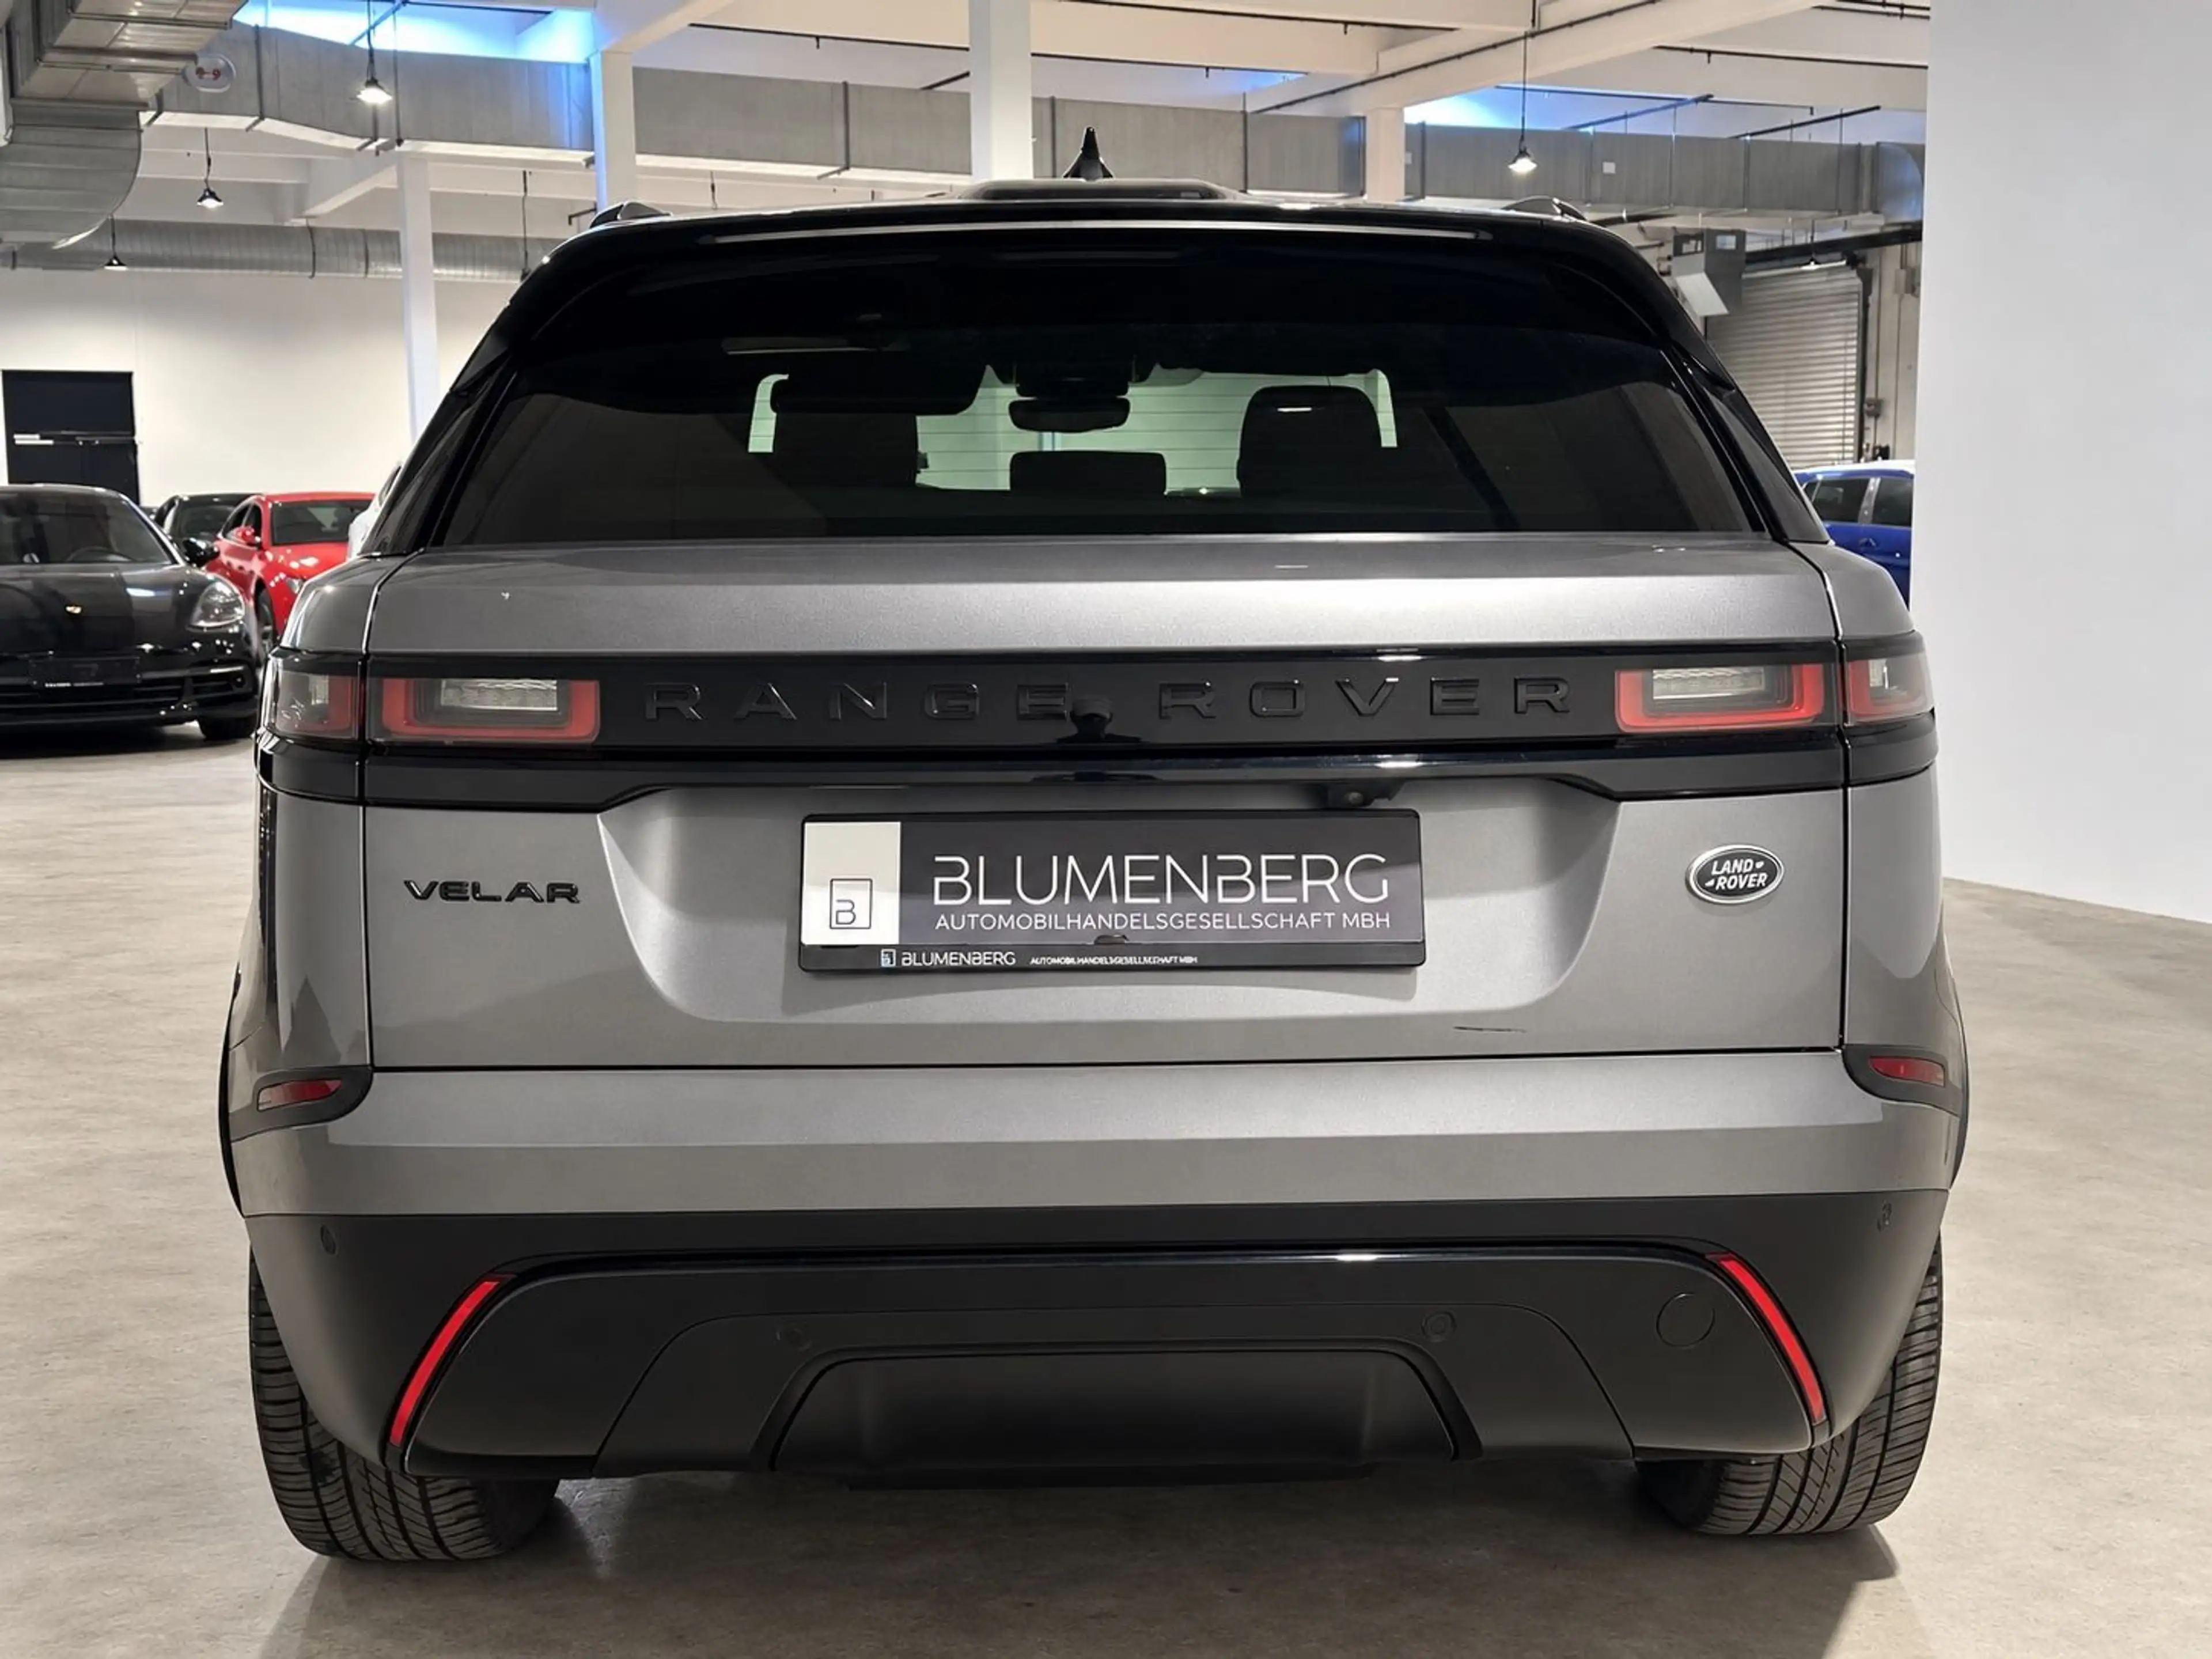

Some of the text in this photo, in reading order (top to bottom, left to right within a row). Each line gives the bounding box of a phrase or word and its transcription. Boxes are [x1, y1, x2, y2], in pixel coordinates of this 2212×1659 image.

[643, 676, 1571, 722] RANGE ROVER
[1711, 858, 1753, 875] LAND
[934, 853, 1389, 905] BLUMENBERG
[1715, 872, 1768, 891] ROVER
[403, 879, 580, 904] VELAR
[934, 911, 1389, 930] AUTOMOBILHANDELSGESELLSCHAFT MBH
[901, 951, 1016, 967] BLUMENBERG
